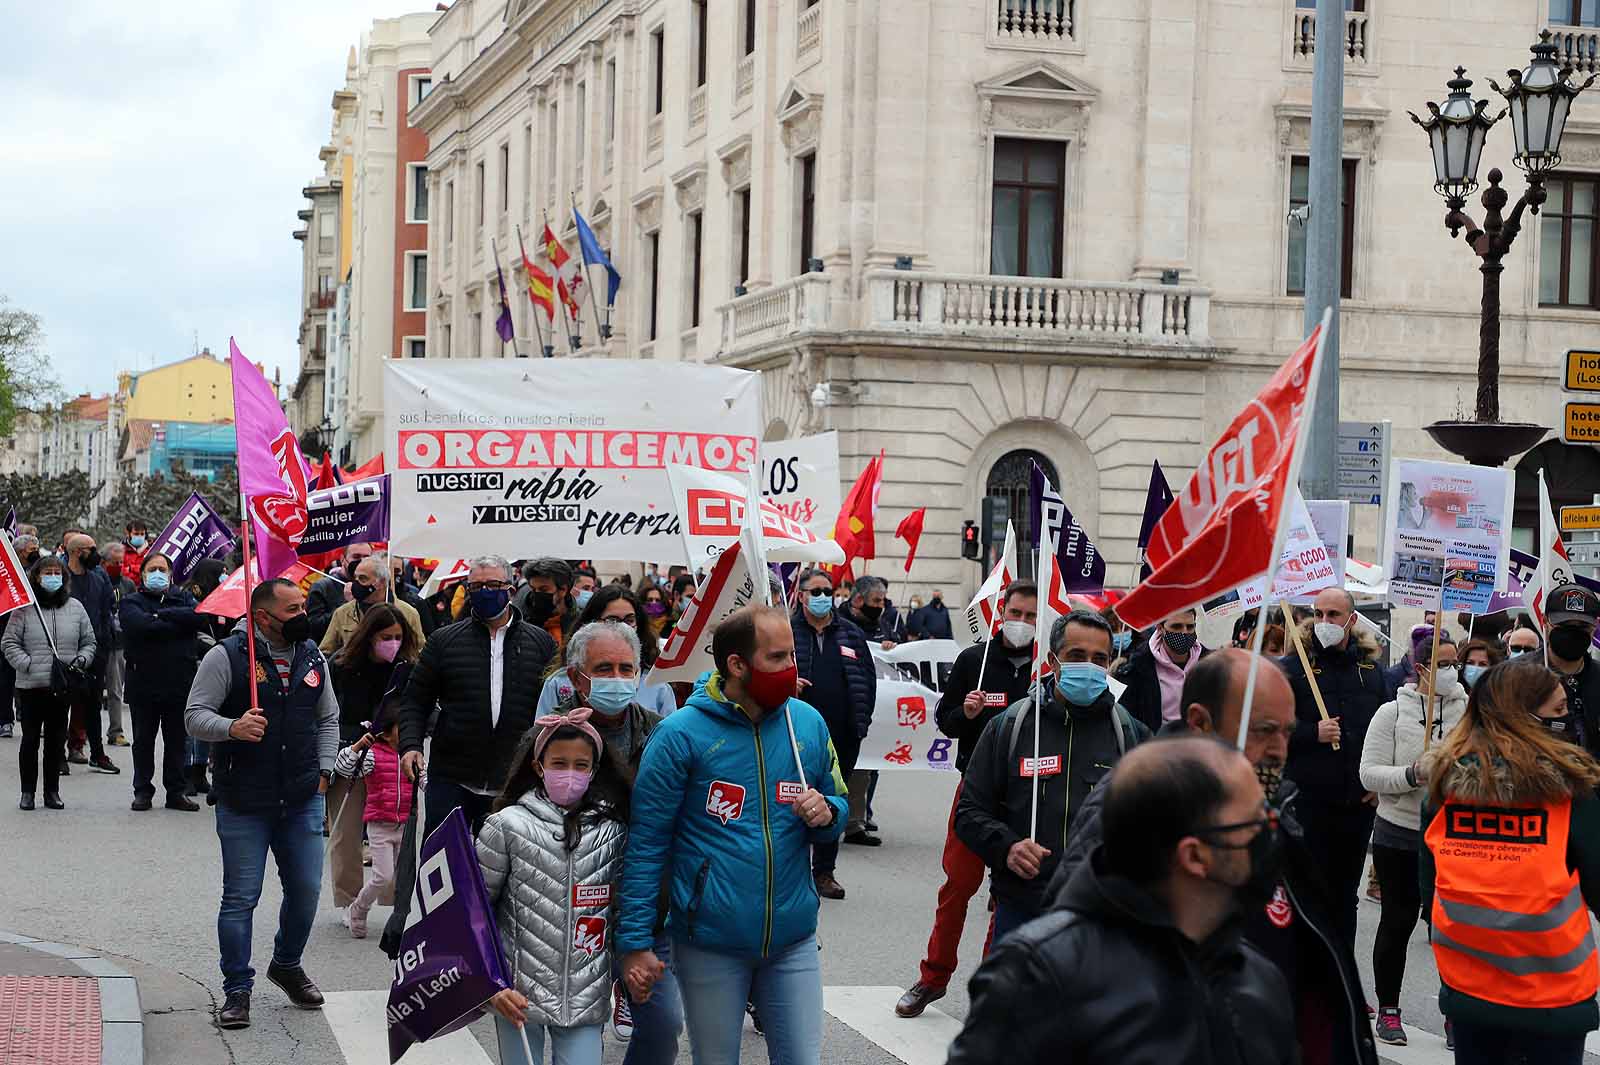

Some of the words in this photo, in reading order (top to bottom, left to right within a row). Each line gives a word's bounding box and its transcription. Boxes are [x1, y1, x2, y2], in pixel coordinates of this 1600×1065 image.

[400, 412, 419, 424] sus
[504, 414, 551, 425] nuestra
[404, 431, 756, 471] ORGANICEMOS
[418, 473, 502, 490] nuestra
[504, 466, 603, 505] rabia
[1179, 417, 1260, 548] UGT
[306, 481, 380, 511] COO
[311, 511, 354, 527] mujer
[473, 506, 487, 524] y
[495, 504, 580, 521] nuestra
[160, 501, 210, 563] CCOO
[204, 531, 221, 547] León
[337, 531, 343, 540] y
[345, 525, 367, 537] León
[186, 531, 205, 558] mujer
[1300, 547, 1326, 566] CCOO
[1306, 571, 1315, 581] en
[1313, 565, 1333, 579] Lucha
[967, 607, 980, 634] tilla
[1027, 759, 1055, 767] COO
[1453, 811, 1542, 837] CCOO
[1440, 847, 1451, 856] de
[1454, 848, 1488, 858] Castilla
[1489, 853, 1496, 861] y
[1498, 853, 1520, 861] León
[1442, 841, 1495, 851] comisiones
[1496, 843, 1532, 853] obreras
[580, 888, 607, 897] CCOO
[394, 940, 427, 986] jer
[409, 990, 425, 1010] y
[419, 966, 462, 998] León
